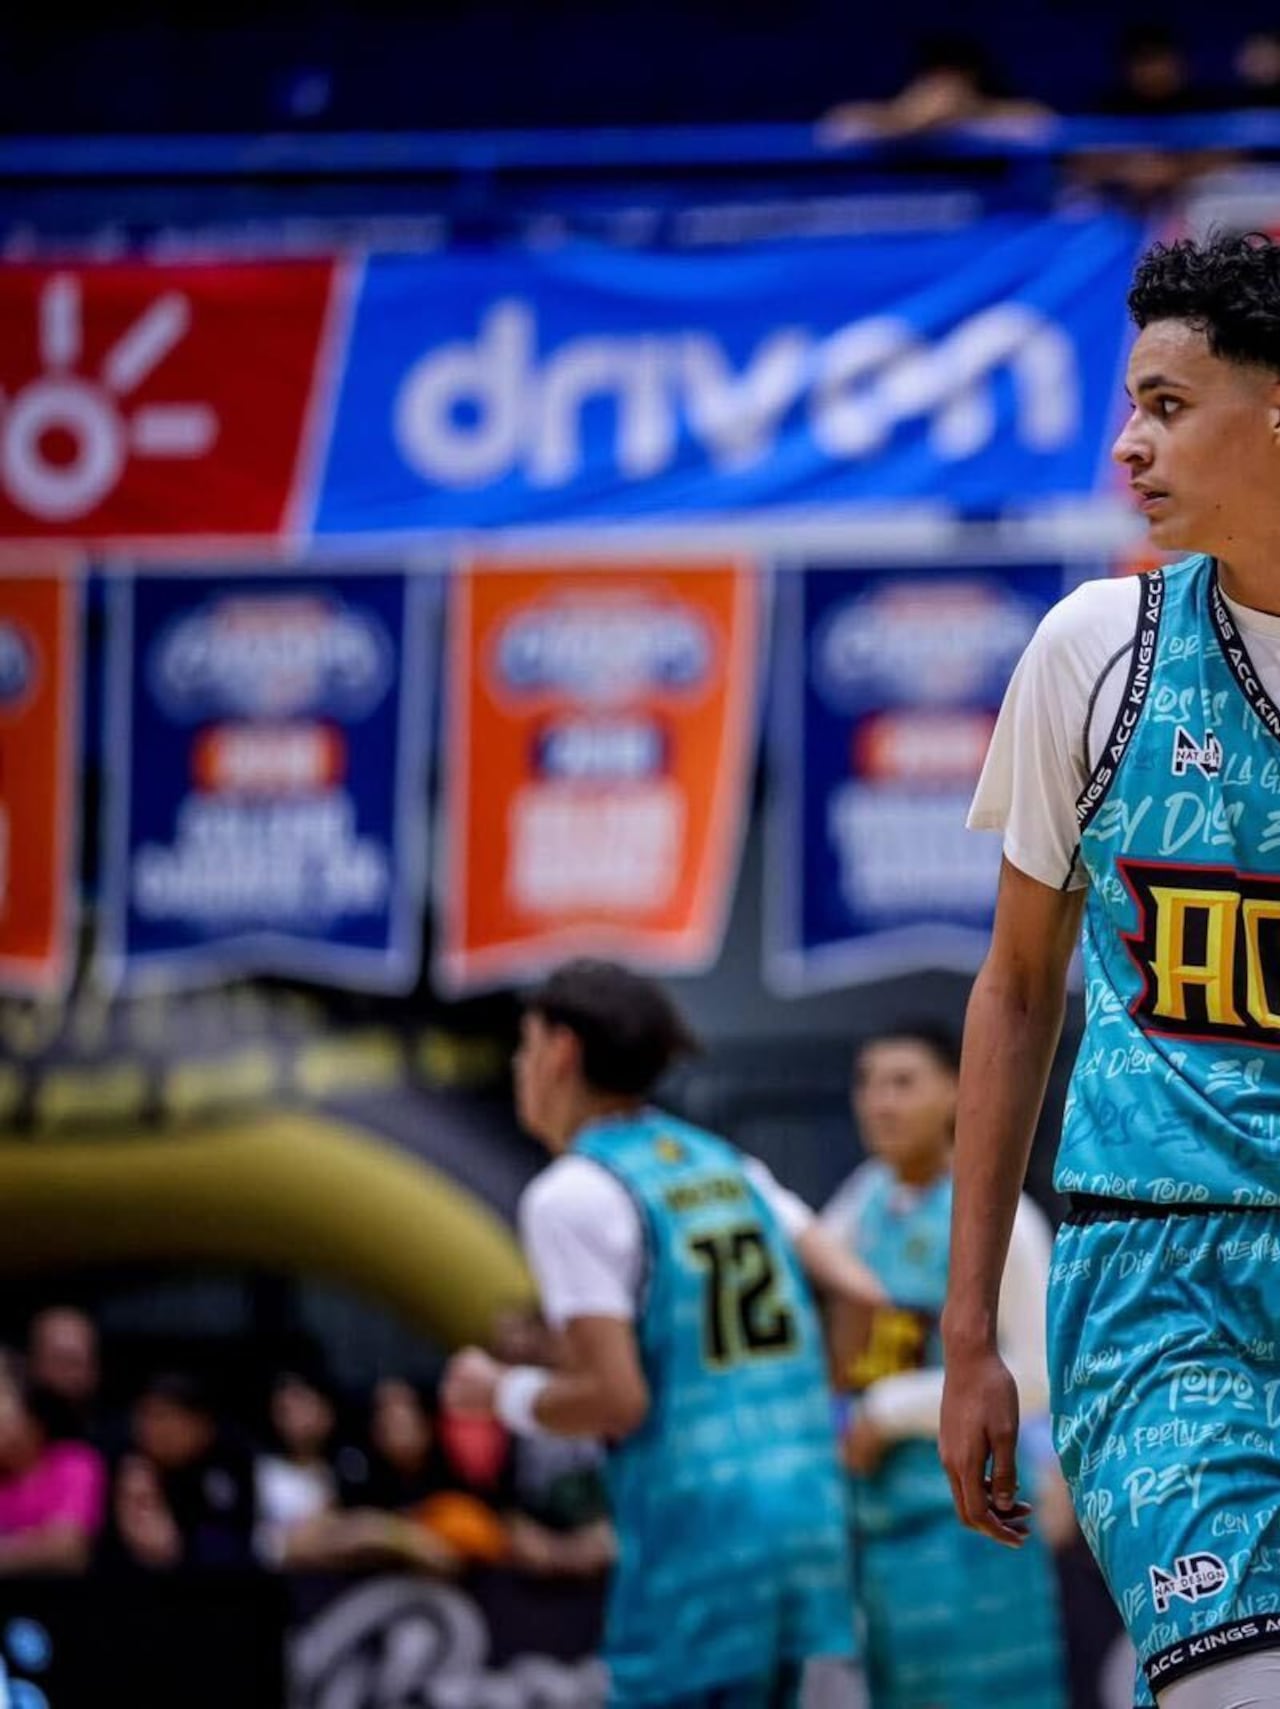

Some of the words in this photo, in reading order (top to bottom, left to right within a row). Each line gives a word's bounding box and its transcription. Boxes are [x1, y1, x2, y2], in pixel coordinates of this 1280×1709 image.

[1109, 709, 1138, 763] ACC
[1129, 629, 1155, 705] KINGS
[1146, 579, 1163, 623] ACC
[1228, 647, 1258, 696] ACC
[1222, 753, 1253, 787] LA
[1204, 1058, 1264, 1095] ES
[1146, 1176, 1210, 1205] TODO
[688, 1224, 797, 1370] 12
[1160, 1361, 1254, 1412] TODO
[1122, 1457, 1210, 1528] REY
[1211, 1509, 1249, 1537] CON
[1155, 1581, 1177, 1597] NAT
[1181, 1570, 1226, 1589] DESIGN
[1150, 1649, 1184, 1679] ACC
[1189, 1623, 1258, 1657] KINGS
